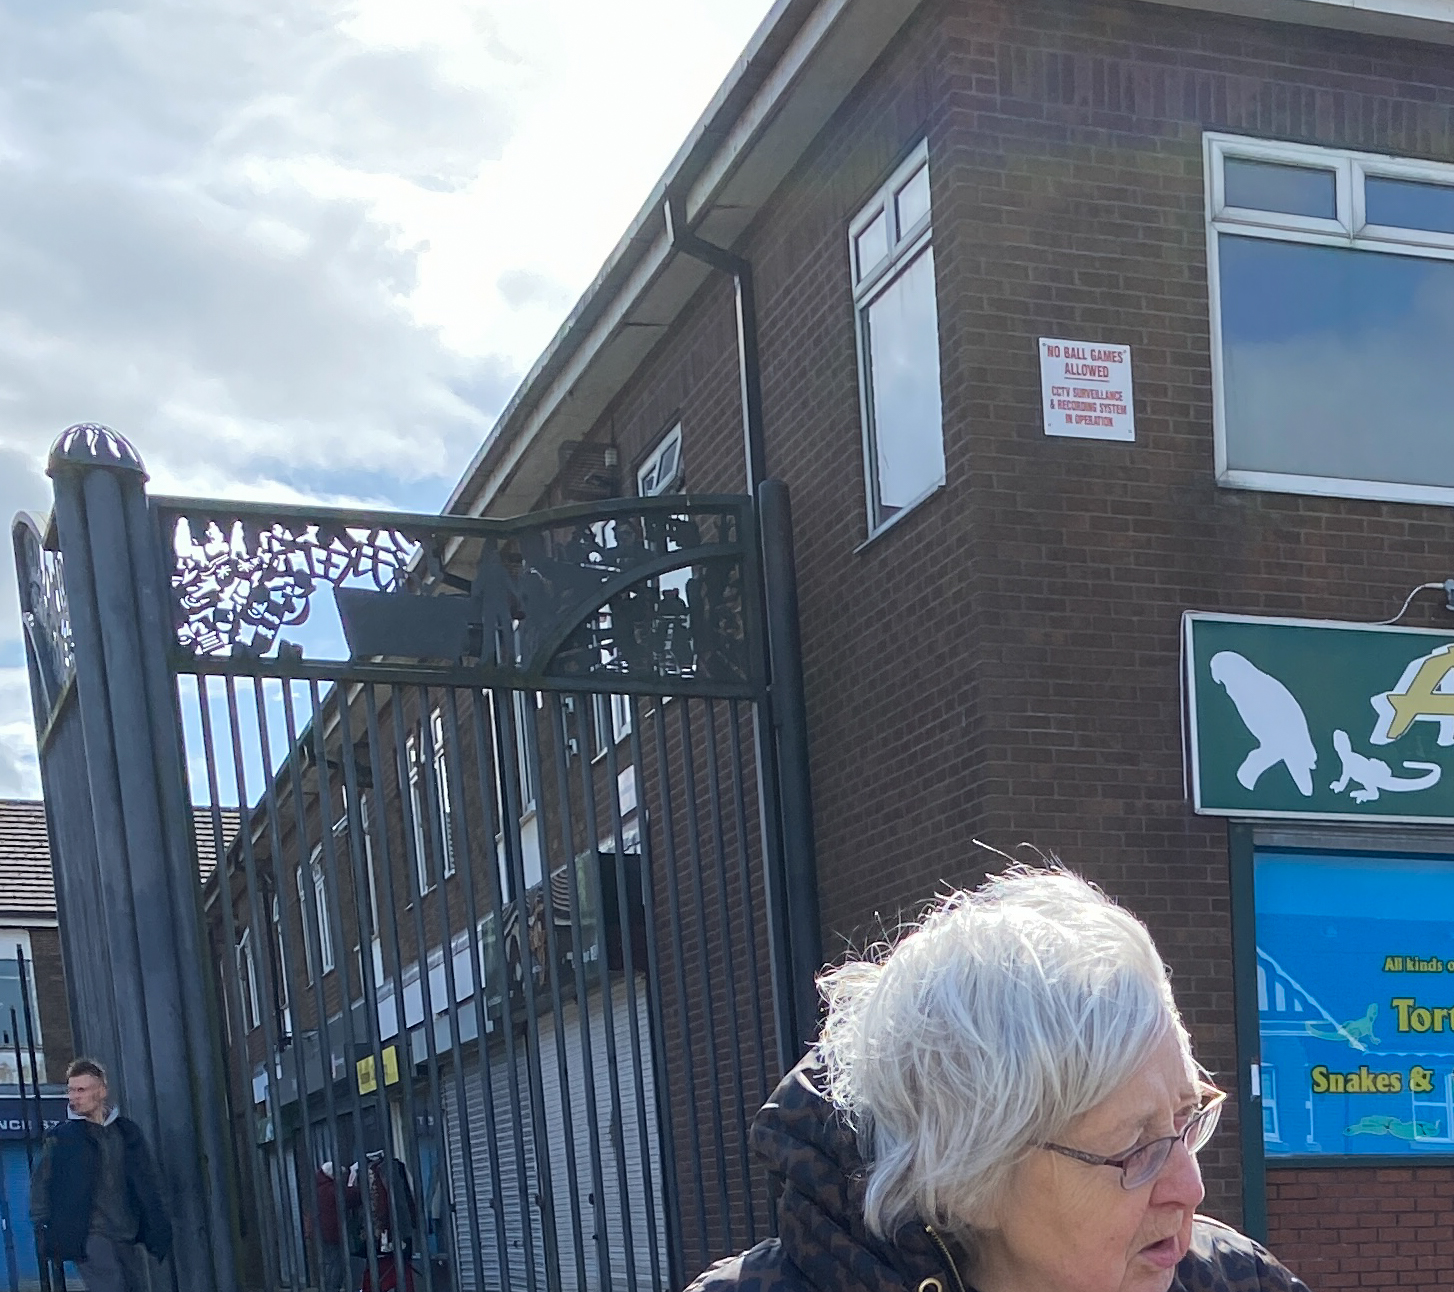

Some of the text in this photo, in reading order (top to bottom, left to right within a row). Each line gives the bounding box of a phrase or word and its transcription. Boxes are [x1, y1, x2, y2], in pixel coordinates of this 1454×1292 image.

[1047, 345, 1123, 363] NO BALL GAMES
[1065, 362, 1109, 378] ALLOWED
[1051, 386, 1071, 397] CCTV
[1100, 403, 1127, 415] SYSTEM
[1065, 414, 1072, 424] IN
[1383, 956, 1403, 973] All
[1405, 956, 1444, 973] kinds
[1311, 1064, 1435, 1095] Snakes &
